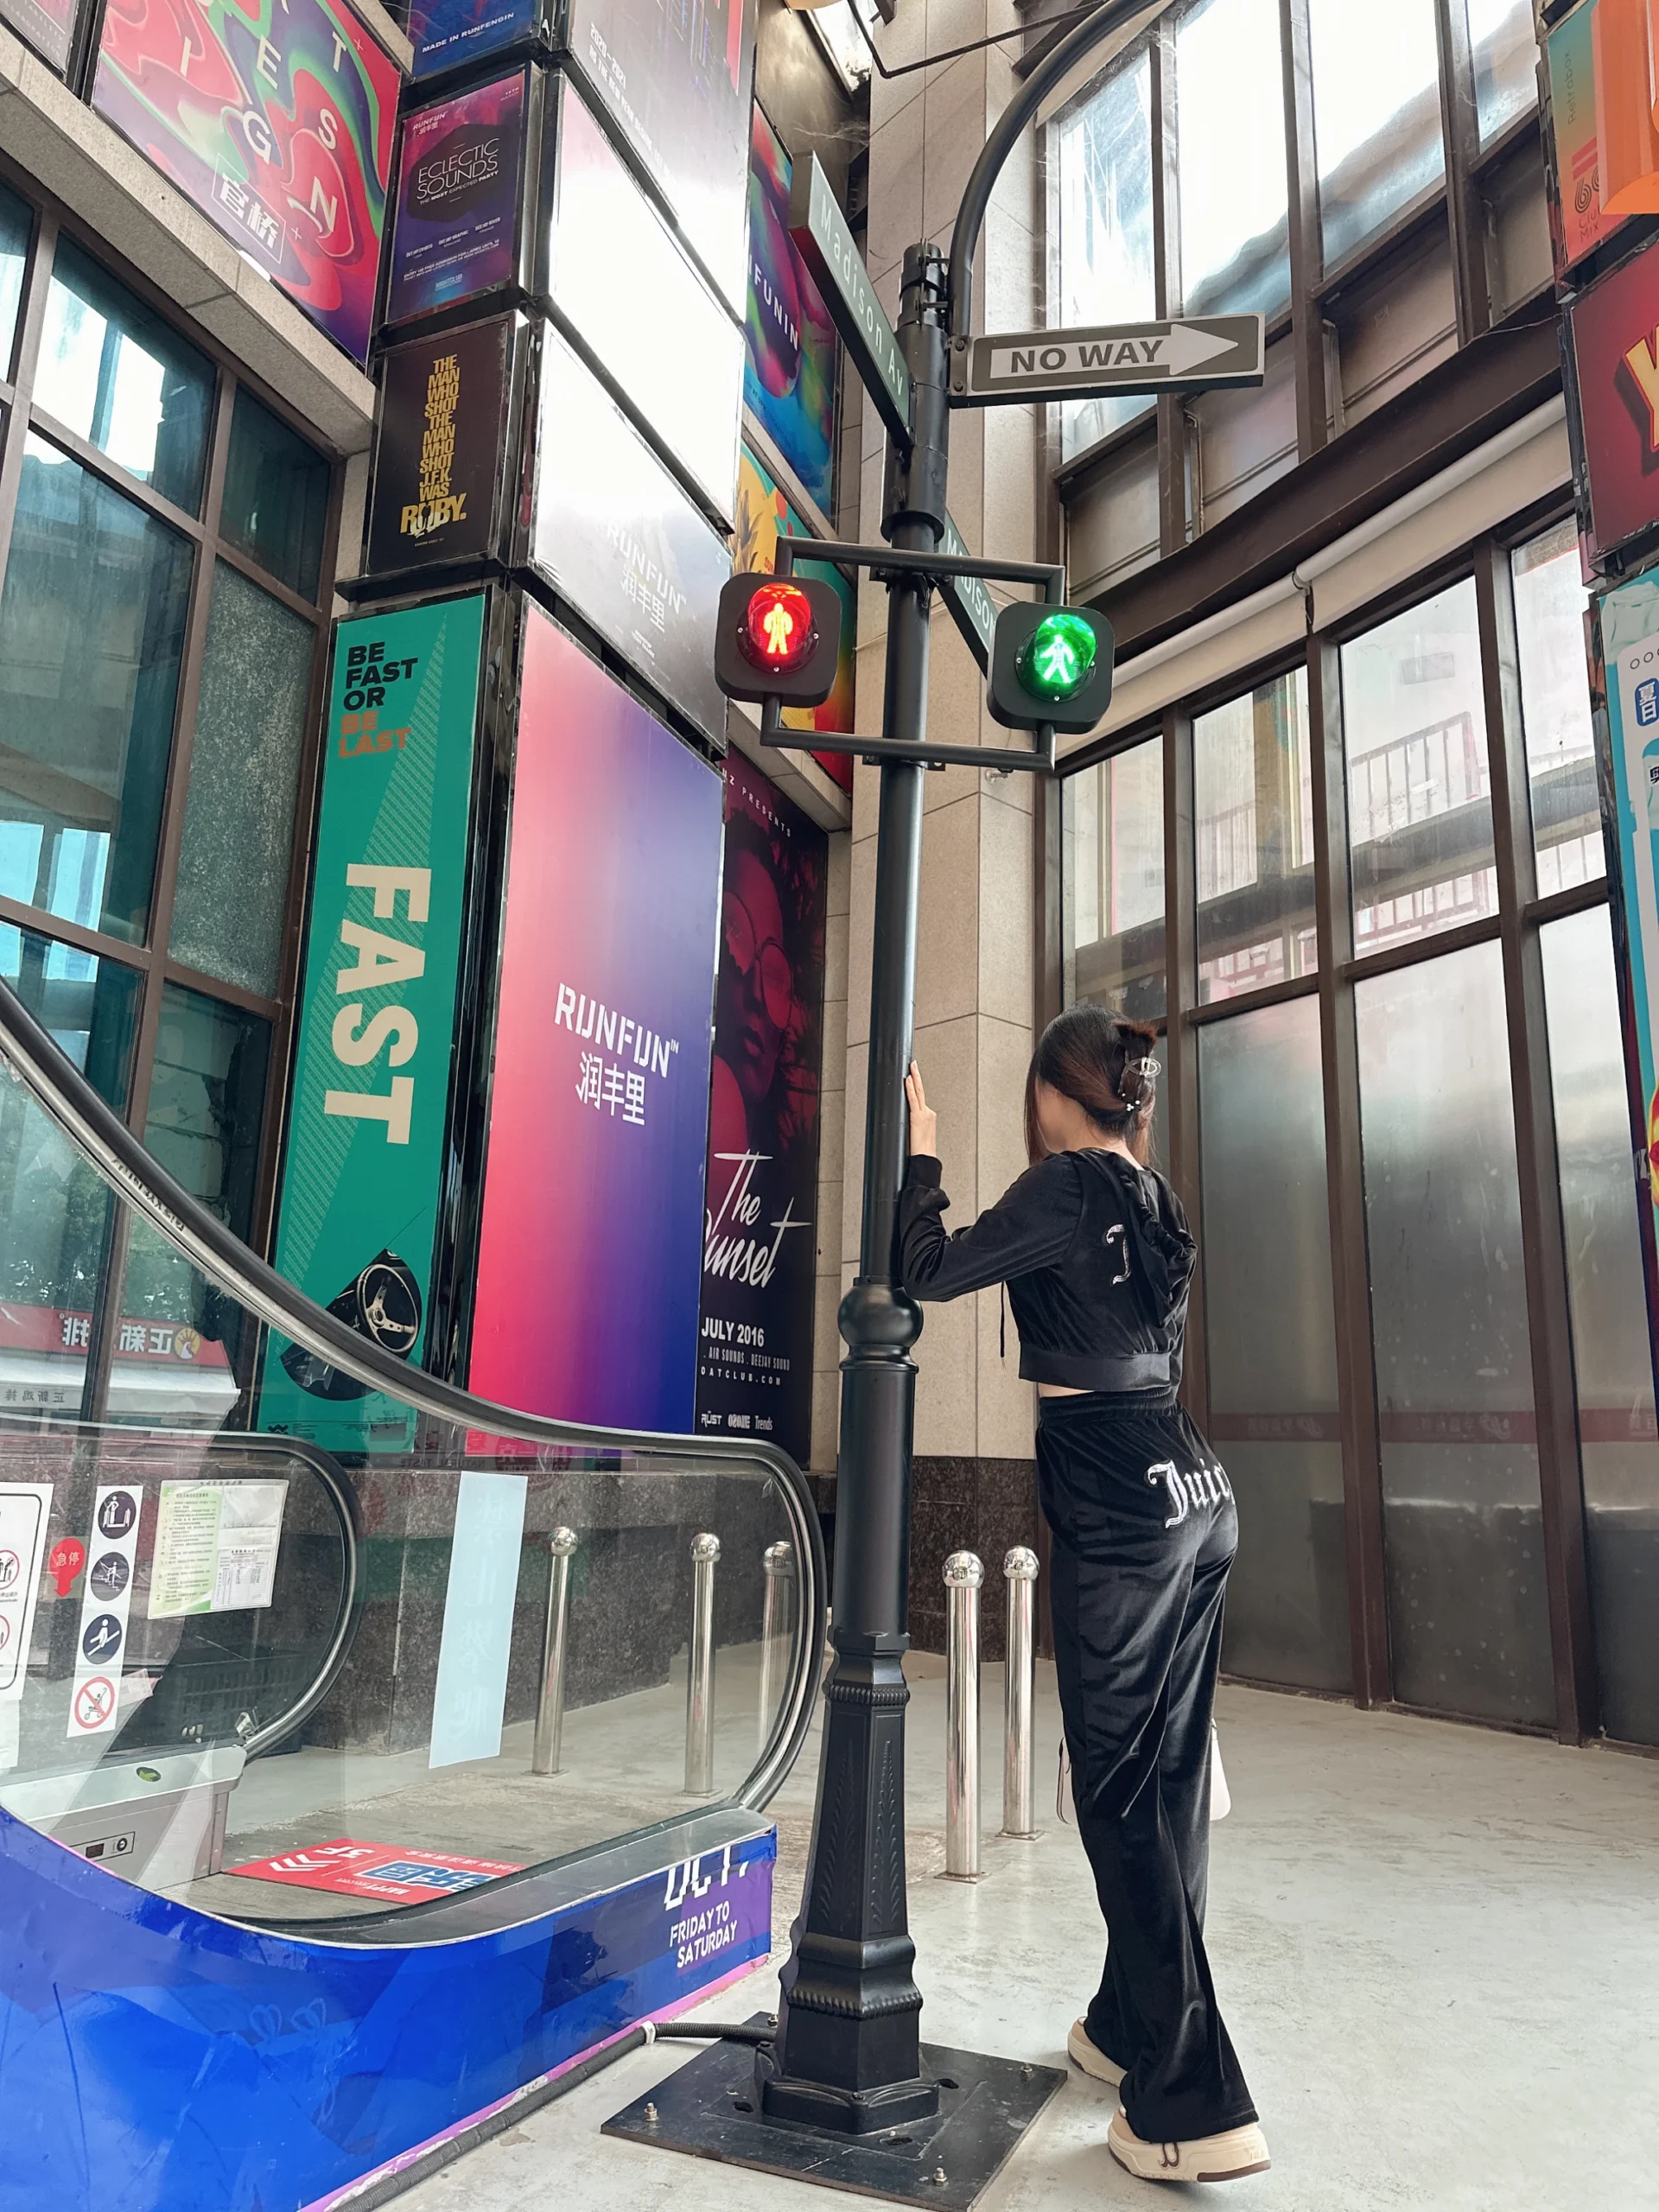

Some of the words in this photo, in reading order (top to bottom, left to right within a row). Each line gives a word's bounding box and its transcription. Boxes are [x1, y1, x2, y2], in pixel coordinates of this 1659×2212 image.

[422, 39, 448, 53] MADE
[461, 12, 515, 37] RUNFENGIN
[1564, 51, 1577, 124] Retrobox
[413, 112, 446, 130] RUNFUN
[418, 138, 500, 183] ECLECTIC
[416, 155, 498, 200] SOUNDS
[431, 191, 448, 200] MOST
[449, 180, 478, 194] EXPECTED
[479, 170, 499, 181] PARTY
[219, 173, 279, 249] 官桥
[1579, 210, 1599, 230] Clu
[1580, 222, 1599, 244] Mix
[820, 194, 883, 354] Madison
[887, 347, 903, 396] Av
[433, 353, 458, 374] THE
[1010, 346, 1067, 373] NO
[1078, 340, 1164, 369] WAY
[427, 381, 460, 403] WHO
[428, 367, 461, 389] MAN
[424, 395, 460, 418] SHOT
[429, 410, 453, 430] THE
[422, 438, 454, 460] WHO
[423, 423, 456, 445] MAN
[419, 452, 454, 474] SHOT
[419, 481, 449, 502] WAS
[607, 521, 682, 615] RUNFUN
[947, 528, 996, 638] MDISON
[620, 563, 665, 633] 润丰里
[347, 641, 385, 667] BE
[346, 658, 419, 689] FAST
[343, 687, 386, 710] OR
[1638, 681, 1657, 723] 夏日
[340, 711, 378, 734] BE
[338, 727, 411, 758] LAST
[742, 787, 791, 837] PRESENTS
[324, 863, 432, 1144] FAST
[554, 982, 671, 1079] RUNFUN
[575, 1051, 646, 1126] 润丰里
[705, 1148, 773, 1236] The
[701, 1317, 734, 1341] JULY
[737, 1324, 765, 1347] 2016
[709, 1346, 720, 1360] AIR
[721, 1349, 744, 1364] SOUNDS
[751, 1353, 771, 1369] DEEJAY
[773, 1357, 790, 1370] SOUND
[1147, 1458, 1236, 1529] Juic
[55, 1551, 79, 1567] 急停
[314, 1845, 376, 1859] 3F
[364, 1882, 410, 1896] HAPPY
[670, 1908, 714, 1948] FRIDAY
[715, 1900, 730, 1925] TO
[677, 1920, 737, 1968] SATURDAY
